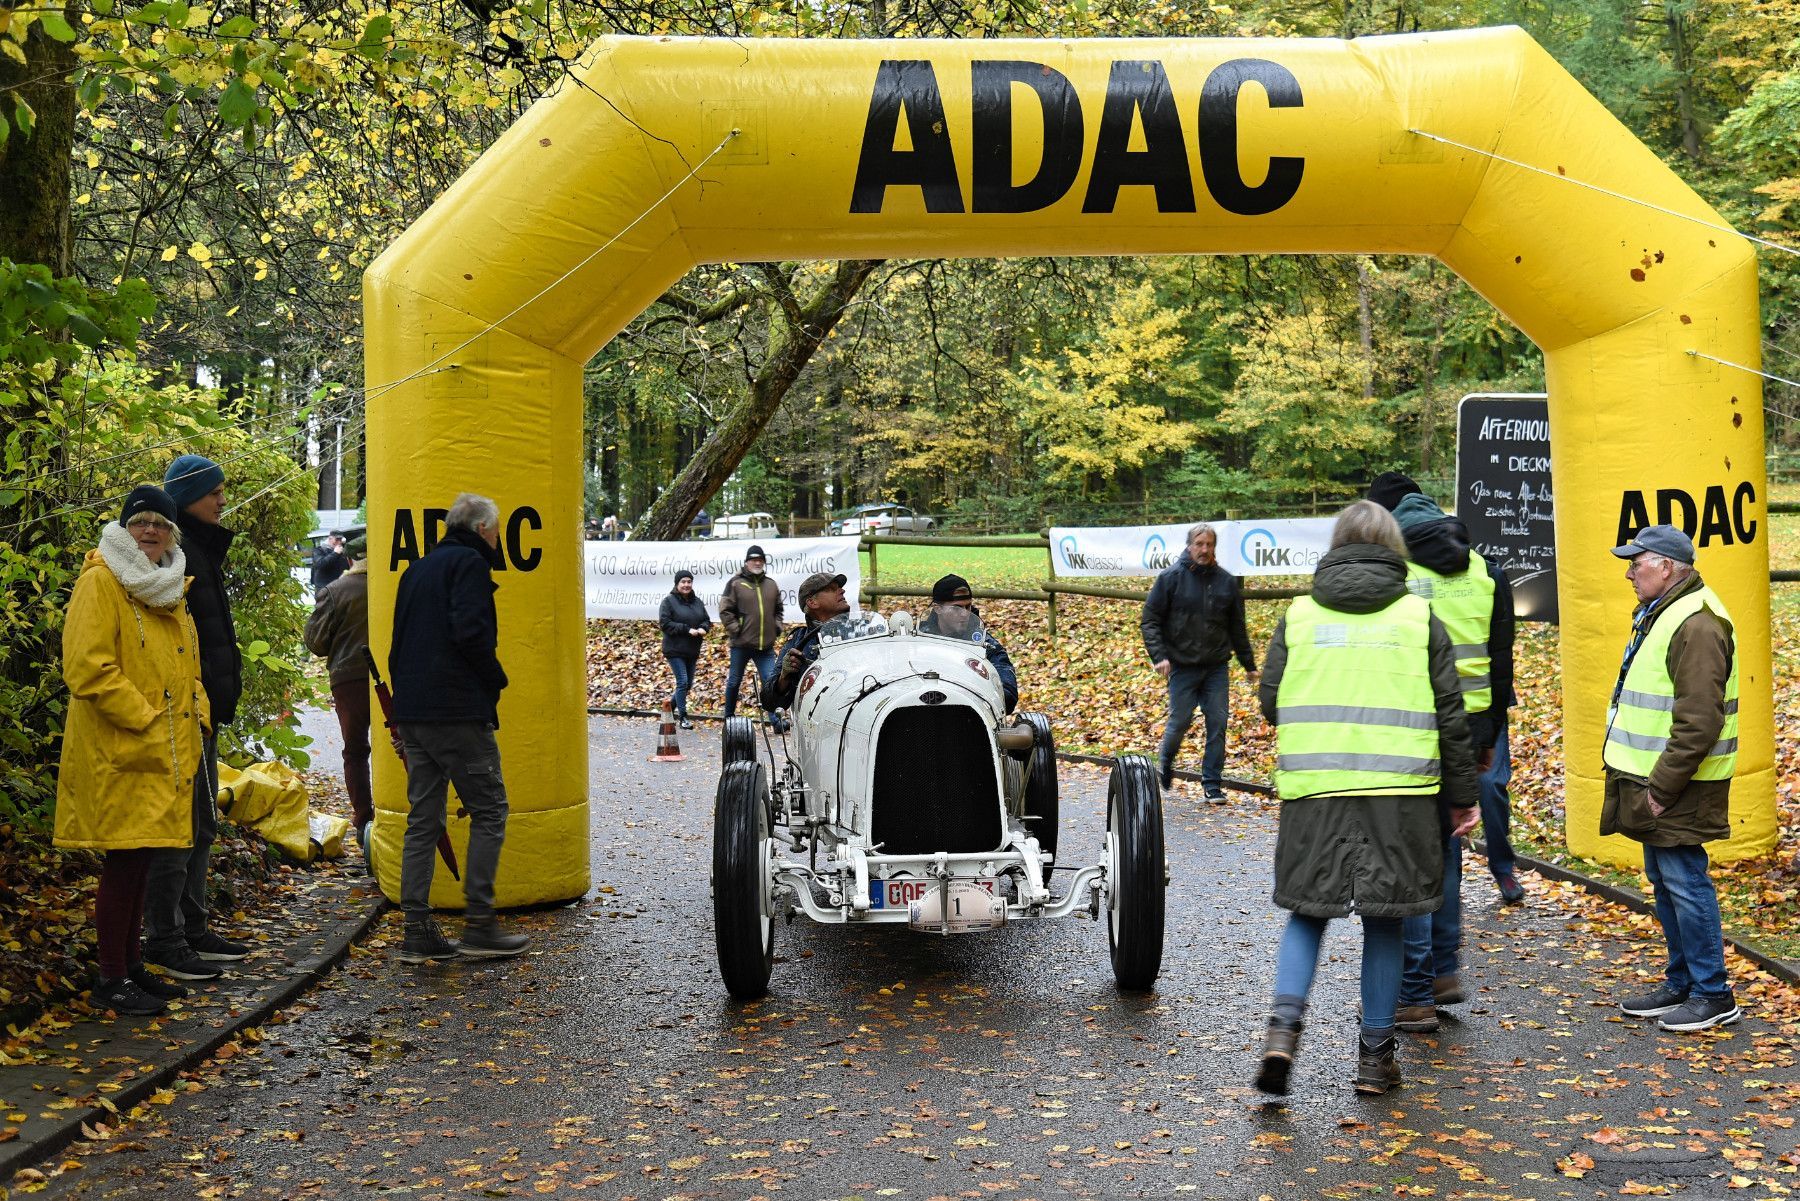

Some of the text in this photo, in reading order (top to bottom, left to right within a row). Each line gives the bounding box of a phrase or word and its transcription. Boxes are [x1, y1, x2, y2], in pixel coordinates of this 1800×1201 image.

[849, 58, 1305, 216] ADAC
[1479, 415, 1551, 441] AFTERHOU
[1508, 456, 1552, 472] DIECKM
[1616, 481, 1757, 549] ADAC
[591, 556, 616, 575] 100
[620, 555, 658, 576] Jahre
[1086, 555, 1123, 571] classic
[952, 897, 963, 917] 1
